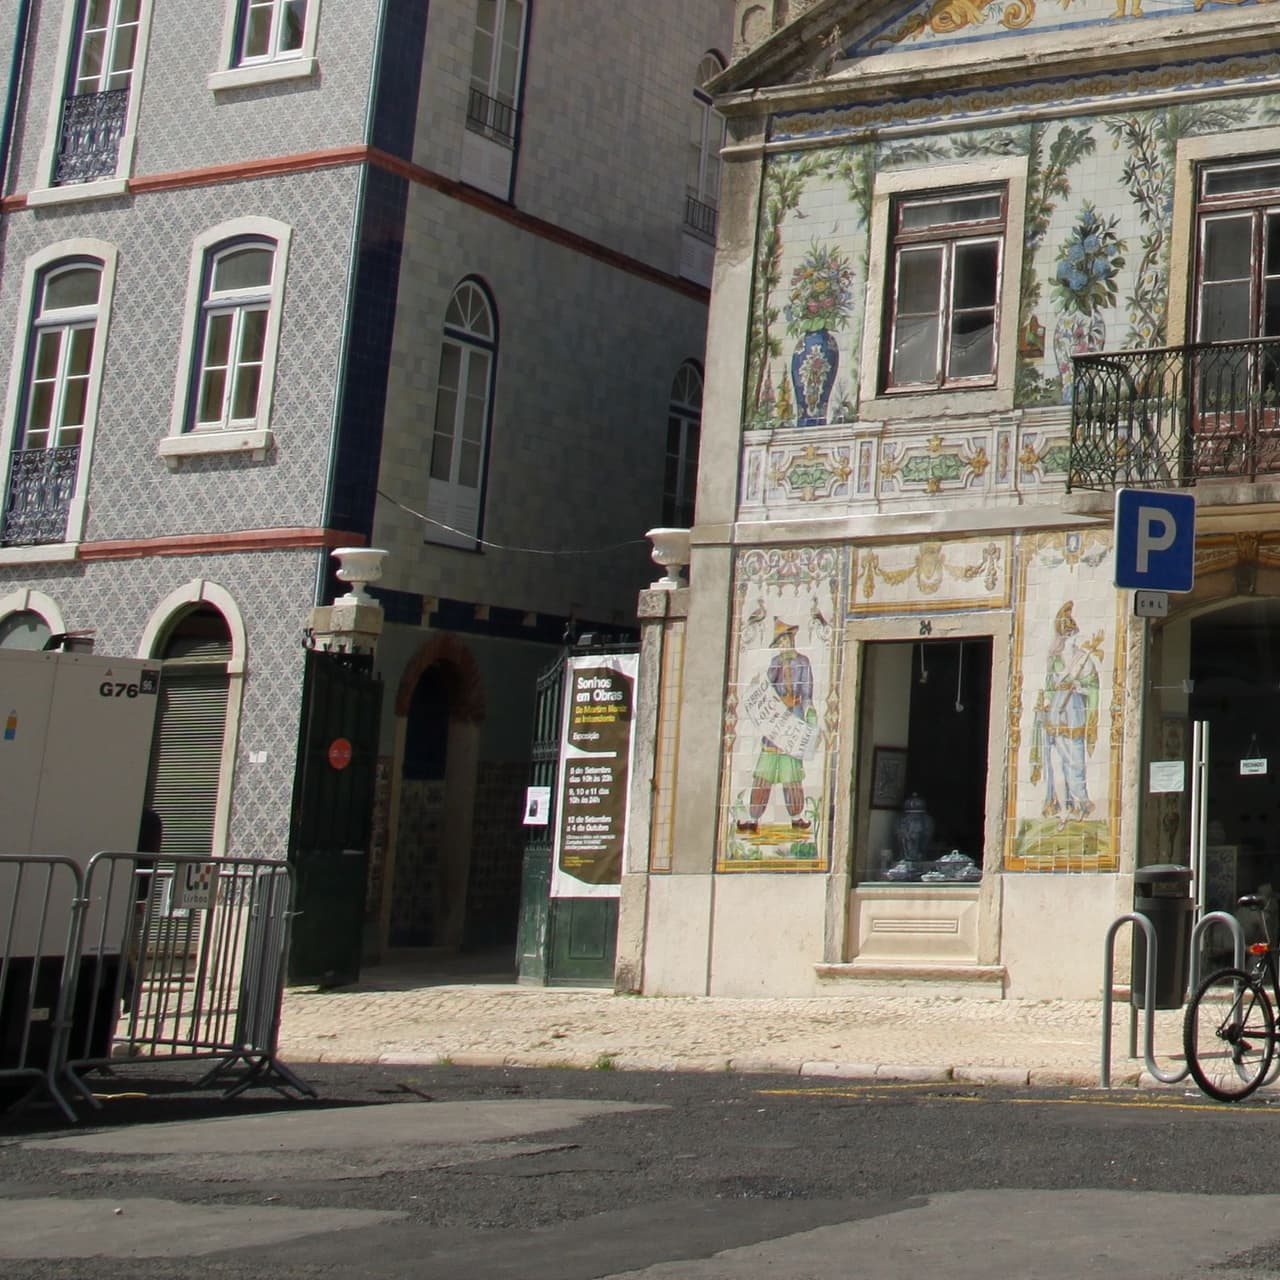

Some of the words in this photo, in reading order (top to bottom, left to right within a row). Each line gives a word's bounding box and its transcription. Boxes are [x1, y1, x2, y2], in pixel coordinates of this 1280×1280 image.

[1136, 506, 1177, 573] P
[99, 681, 139, 698] G76
[577, 676, 612, 689] Sonhos
[576, 692, 590, 702] em
[592, 689, 623, 701] Obras
